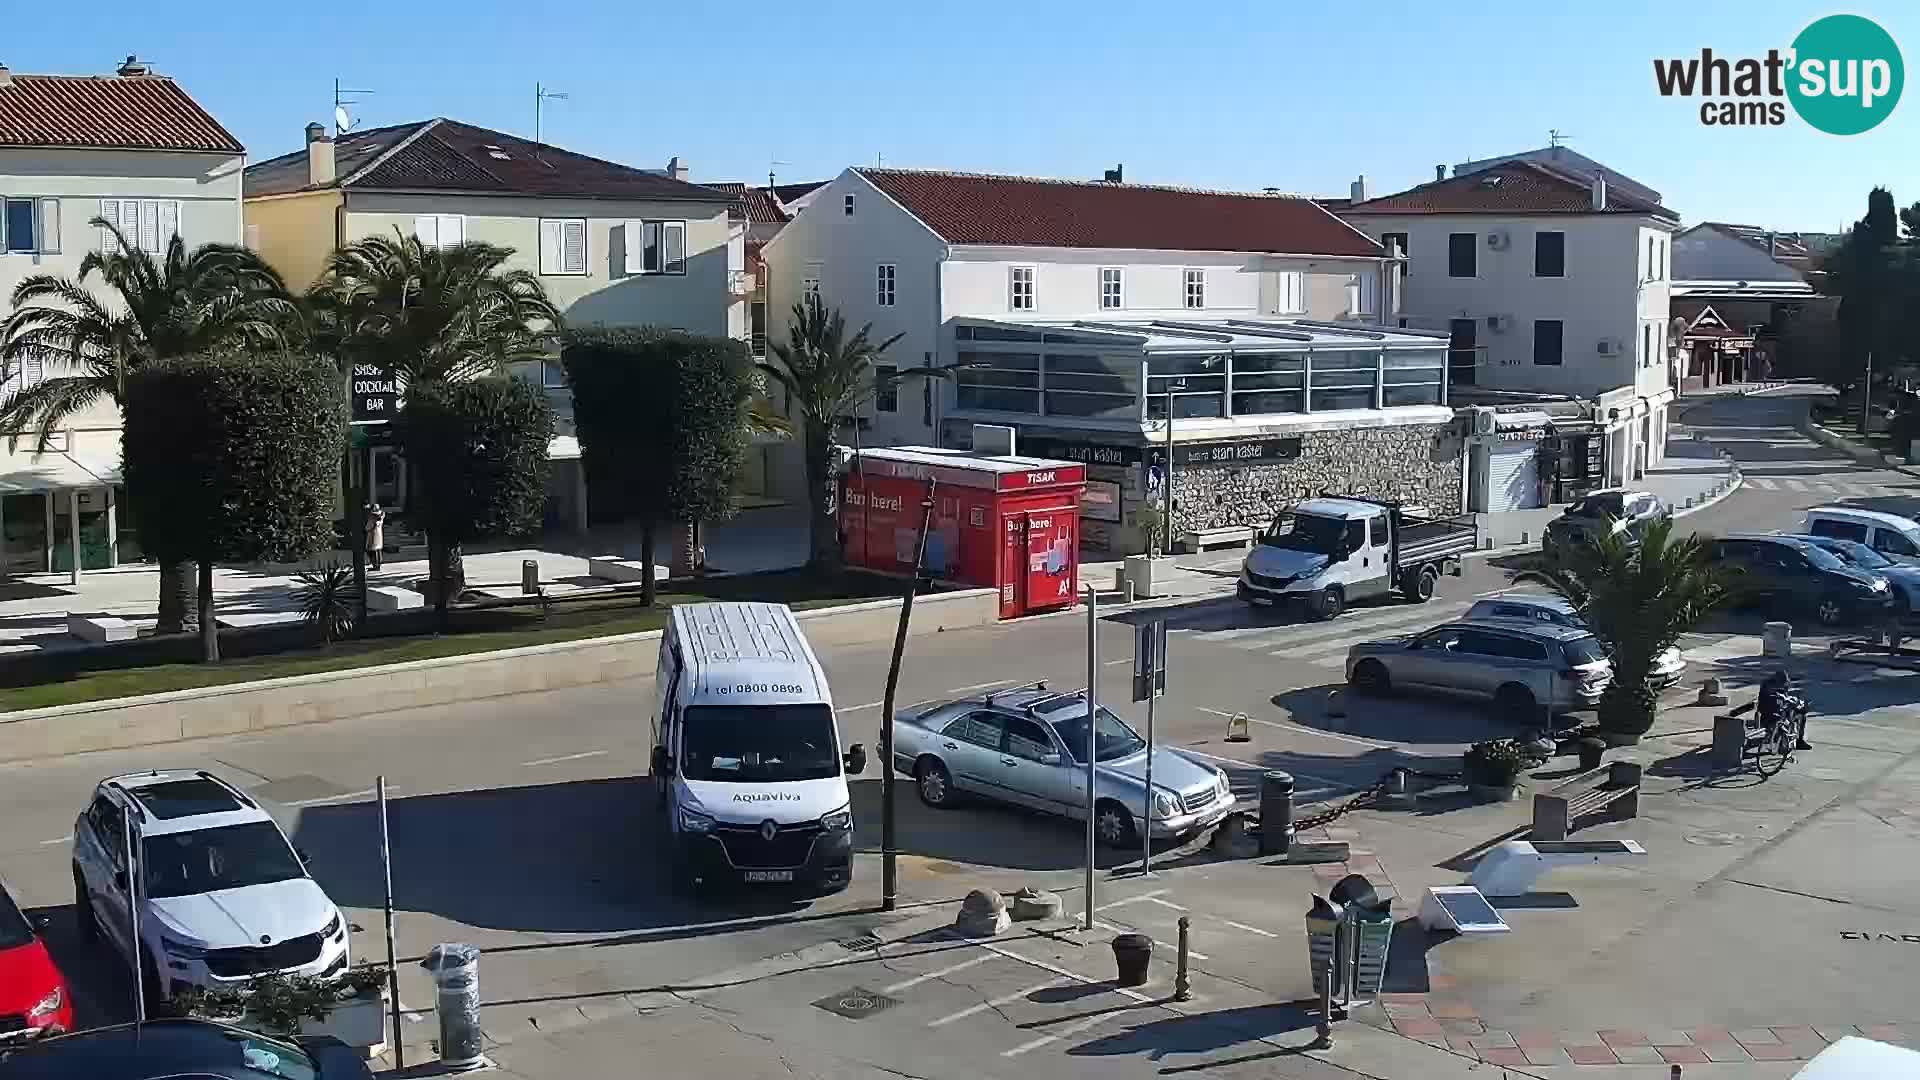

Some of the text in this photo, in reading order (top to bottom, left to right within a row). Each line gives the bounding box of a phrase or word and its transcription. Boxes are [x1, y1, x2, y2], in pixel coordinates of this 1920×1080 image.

[354, 380, 395, 394] COCKTAIL
[366, 398, 384, 411] BAR
[1026, 471, 1056, 485] TISAK
[871, 490, 903, 512] here!
[1007, 516, 1053, 532] Buy here!
[736, 684, 768, 693] 0800
[733, 791, 801, 803] Aquaviva
